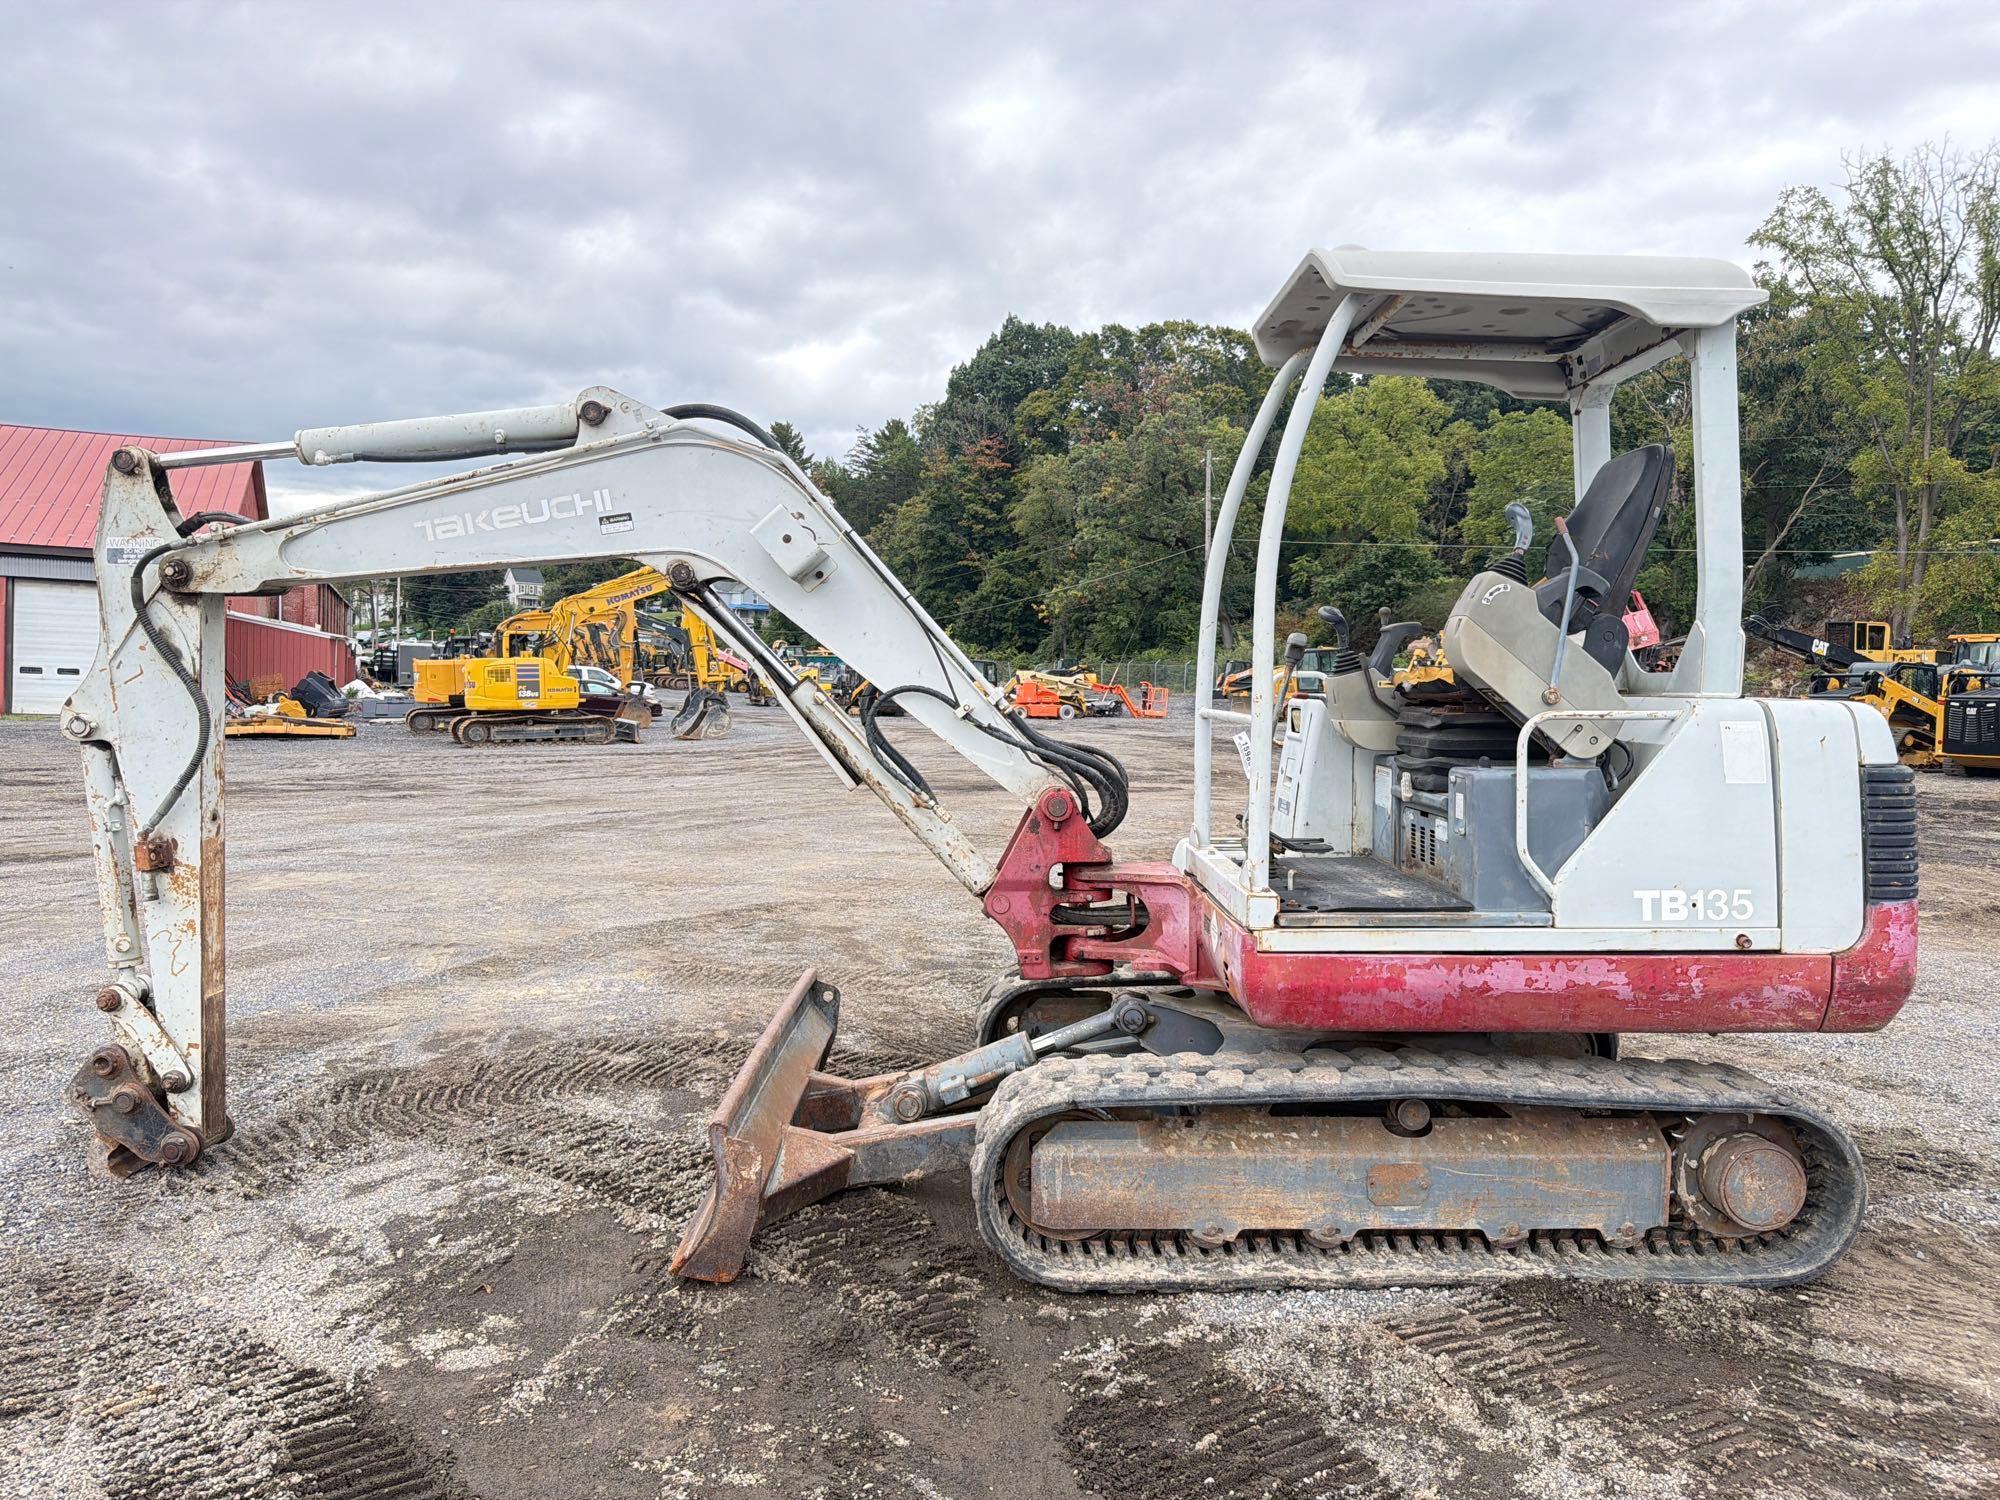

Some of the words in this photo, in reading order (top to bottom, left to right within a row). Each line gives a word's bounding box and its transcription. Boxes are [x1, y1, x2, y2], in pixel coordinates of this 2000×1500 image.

[413, 488, 613, 542] TAKEUCHI
[108, 538, 164, 548] WARNING
[606, 584, 653, 605] KOMATSU
[1811, 638, 1830, 656] CAT
[1633, 889, 1754, 921] TB135
